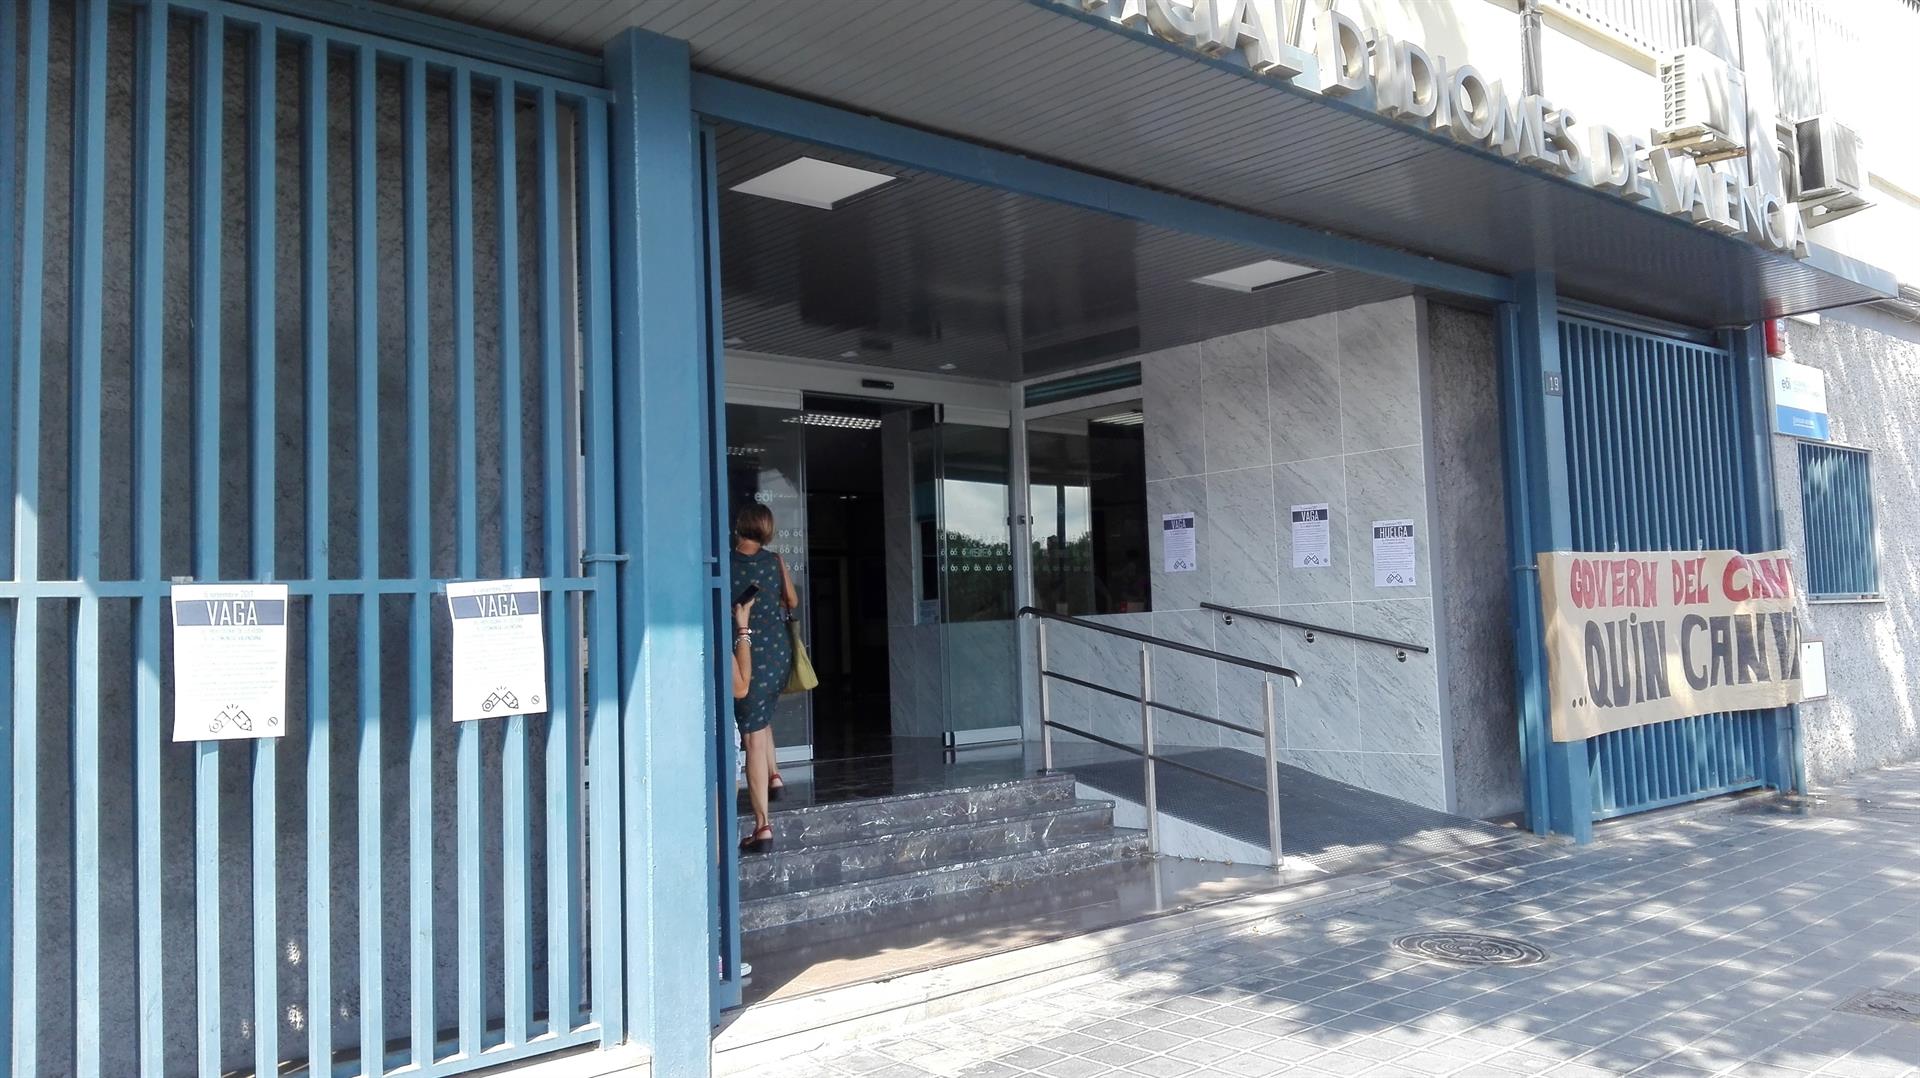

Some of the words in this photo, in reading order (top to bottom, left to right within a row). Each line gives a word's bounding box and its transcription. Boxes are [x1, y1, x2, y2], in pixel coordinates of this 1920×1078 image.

[1589, 124, 1651, 200] DE
[1171, 519, 1187, 530] VAGA
[1301, 510, 1320, 522] VAGA
[1380, 525, 1408, 539] HUELGA
[1570, 557, 1659, 609] GOVERN
[1671, 556, 1710, 606] DEL
[205, 600, 258, 626] VAGA
[475, 593, 520, 618] VAGA
